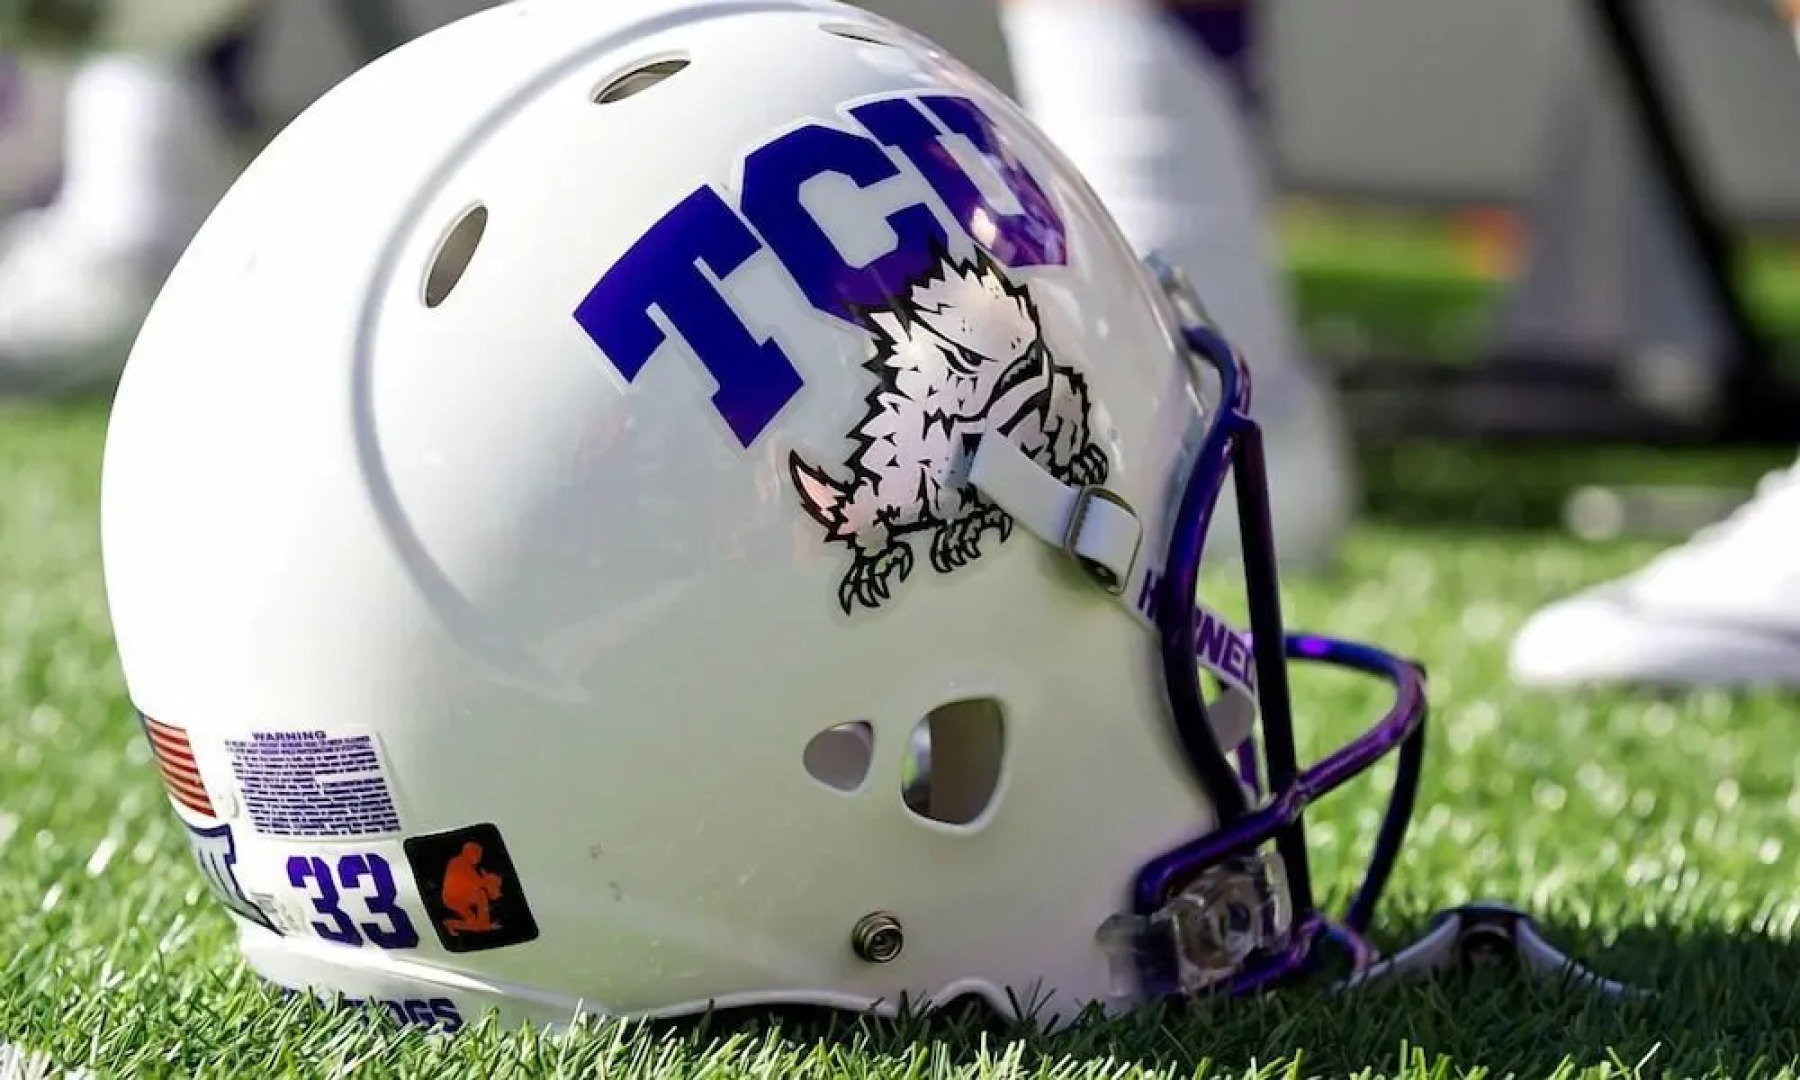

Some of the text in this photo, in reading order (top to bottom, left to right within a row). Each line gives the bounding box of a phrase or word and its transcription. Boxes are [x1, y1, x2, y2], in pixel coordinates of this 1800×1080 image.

[572, 95, 1068, 450] TCU
[1136, 567, 1256, 693] HNE
[251, 730, 327, 741] WARNING
[286, 853, 419, 949] 33
